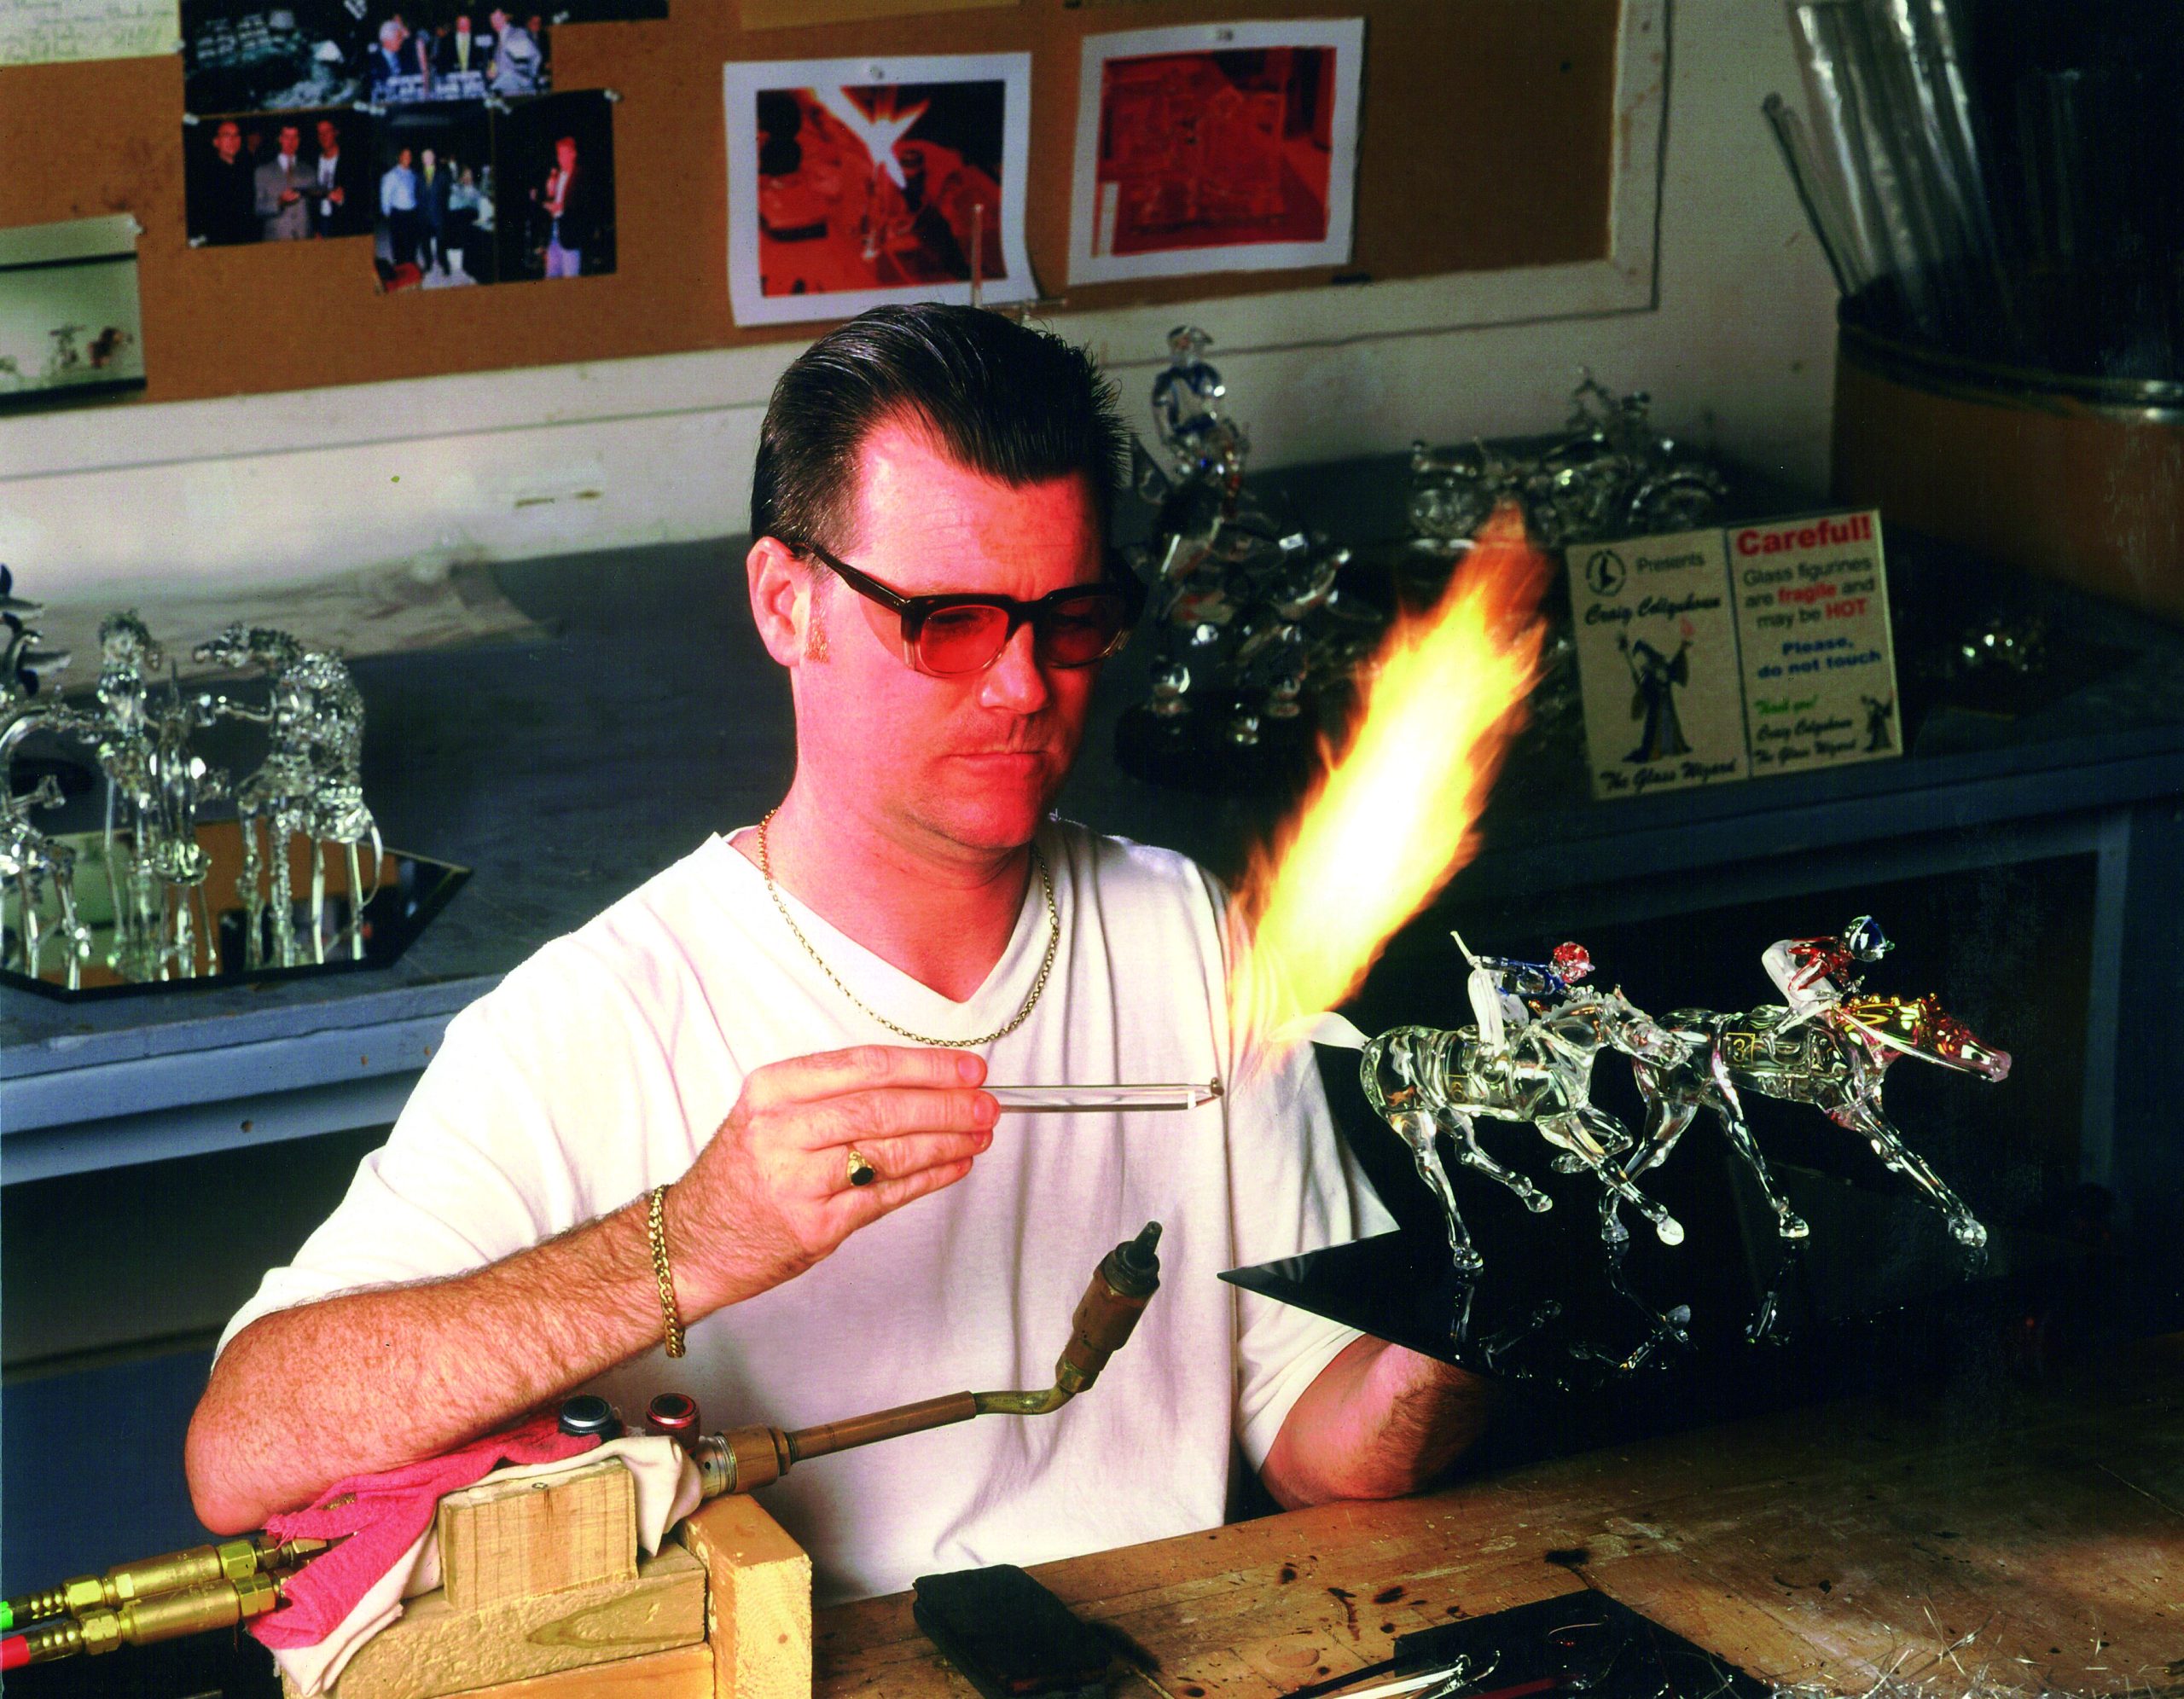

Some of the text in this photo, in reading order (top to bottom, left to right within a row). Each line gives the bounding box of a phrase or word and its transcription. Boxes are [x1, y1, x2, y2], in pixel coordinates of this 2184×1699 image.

[1736, 513, 1872, 557] Careful!
[1635, 552, 1705, 574] Presents
[1743, 556, 1873, 587] Glass figurines
[1745, 575, 1875, 609] are fragile and
[1755, 596, 1867, 629] may be HOT
[1757, 647, 1883, 680] do not touch
[1599, 769, 1629, 792] The
[1632, 767, 1676, 795] Glass
[1732, 1037, 1746, 1063] 3
